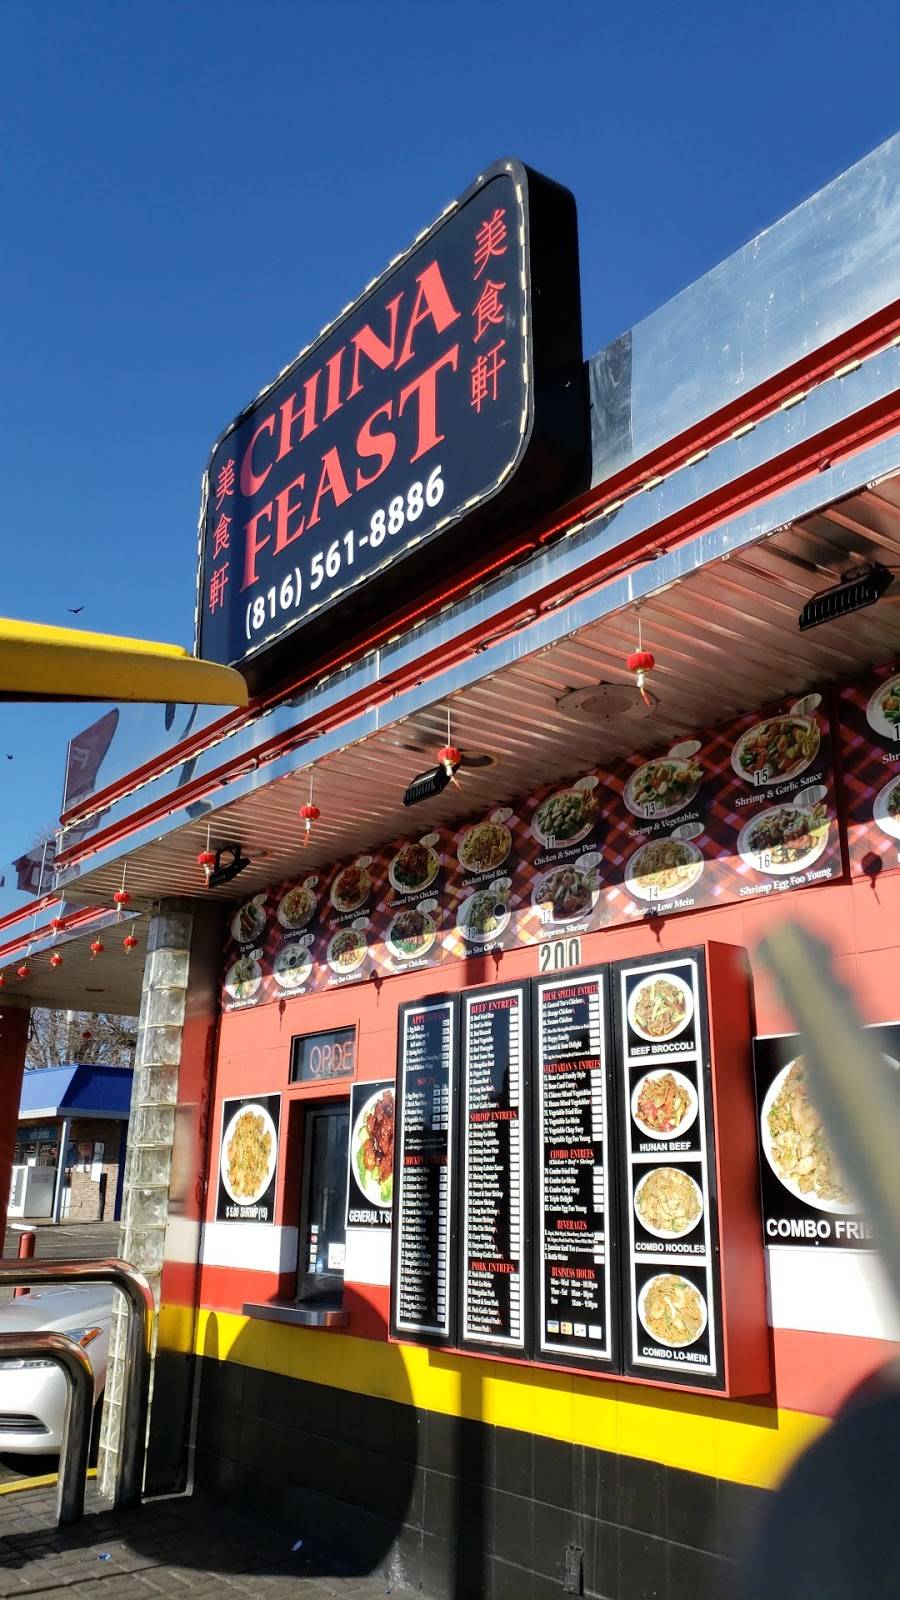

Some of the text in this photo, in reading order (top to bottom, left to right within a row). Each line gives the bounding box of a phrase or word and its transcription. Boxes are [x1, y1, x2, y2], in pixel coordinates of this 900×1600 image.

[471, 208, 508, 413] 美食軒
[240, 259, 462, 498] CHINA
[240, 343, 460, 593] FEAST
[209, 459, 236, 615] 美食軒
[245, 465, 446, 639] (816) 561-8886
[735, 771, 822, 808] Shrimp & Garlic Sauce
[645, 802, 656, 817] 13
[654, 822, 660, 831] &
[661, 812, 700, 829] Vegetables
[534, 855, 557, 866] Chicken
[564, 847, 582, 858] Snow
[582, 843, 597, 853] Peas
[461, 876, 482, 887] Chicken
[740, 866, 832, 897] Shrimp Egg Foo Young
[657, 902, 674, 912] Low
[674, 897, 695, 908] Mein
[566, 923, 589, 934] Shrimp
[630, 1041, 694, 1056] BEEF BROCCOLI
[639, 1141, 691, 1152] HUNAN BEEF
[240, 1206, 258, 1218] SHRIMP
[349, 1209, 379, 1223] GENERAL
[766, 1218, 831, 1239] COMBO
[635, 1242, 706, 1254] COMBO NOODLES
[642, 1346, 708, 1364] COMBO LO-MEIN
